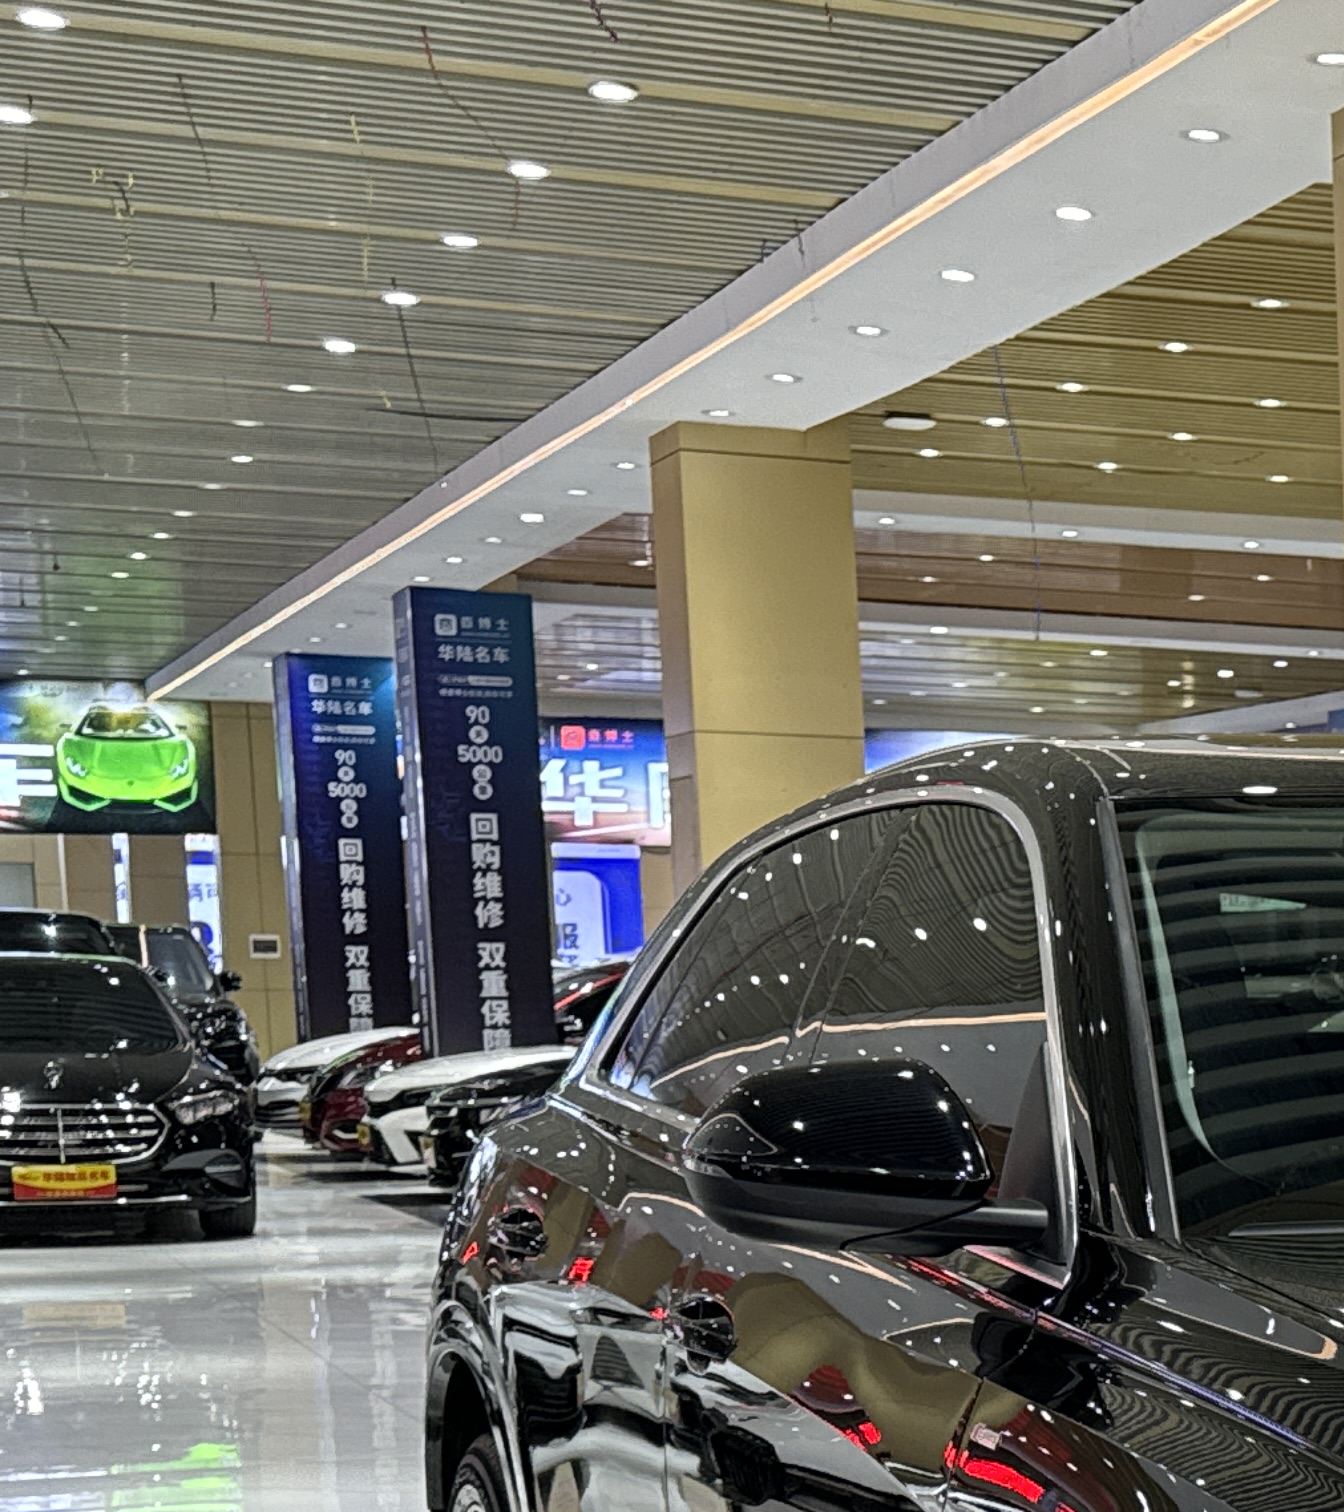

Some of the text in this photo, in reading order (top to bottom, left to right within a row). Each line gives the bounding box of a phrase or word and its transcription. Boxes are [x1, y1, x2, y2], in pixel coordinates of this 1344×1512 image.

[437, 643, 510, 663] 华陆名车
[464, 705, 490, 724] 90
[334, 749, 356, 766] 90
[457, 744, 503, 763] 5000
[328, 781, 367, 798] 5000
[469, 813, 504, 929] 回购维修
[338, 837, 369, 935] 回购维修
